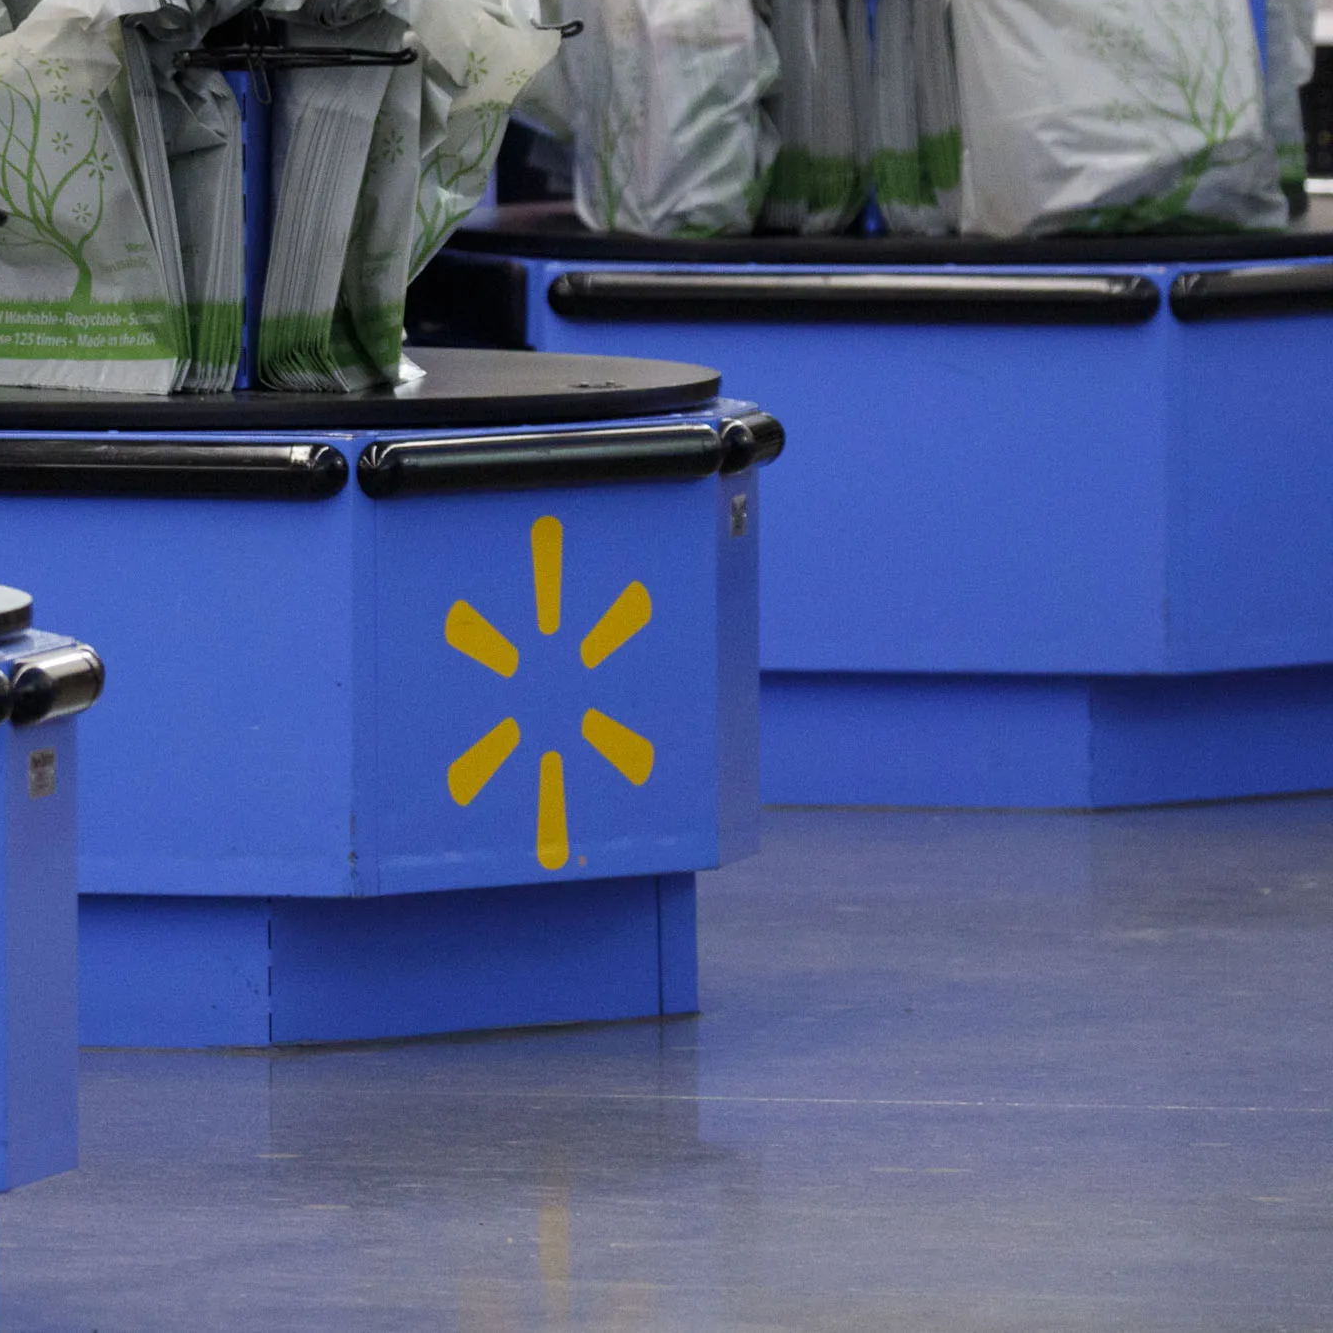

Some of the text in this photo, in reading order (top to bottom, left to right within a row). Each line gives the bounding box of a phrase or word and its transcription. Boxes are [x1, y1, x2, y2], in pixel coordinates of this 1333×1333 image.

[5, 312, 58, 325] Washable
[65, 312, 120, 328] Recyclable
[15, 333, 34, 346] 125
[37, 333, 66, 346] times
[78, 335, 106, 347] Made
[120, 334, 135, 346] the
[137, 334, 156, 346] USA
